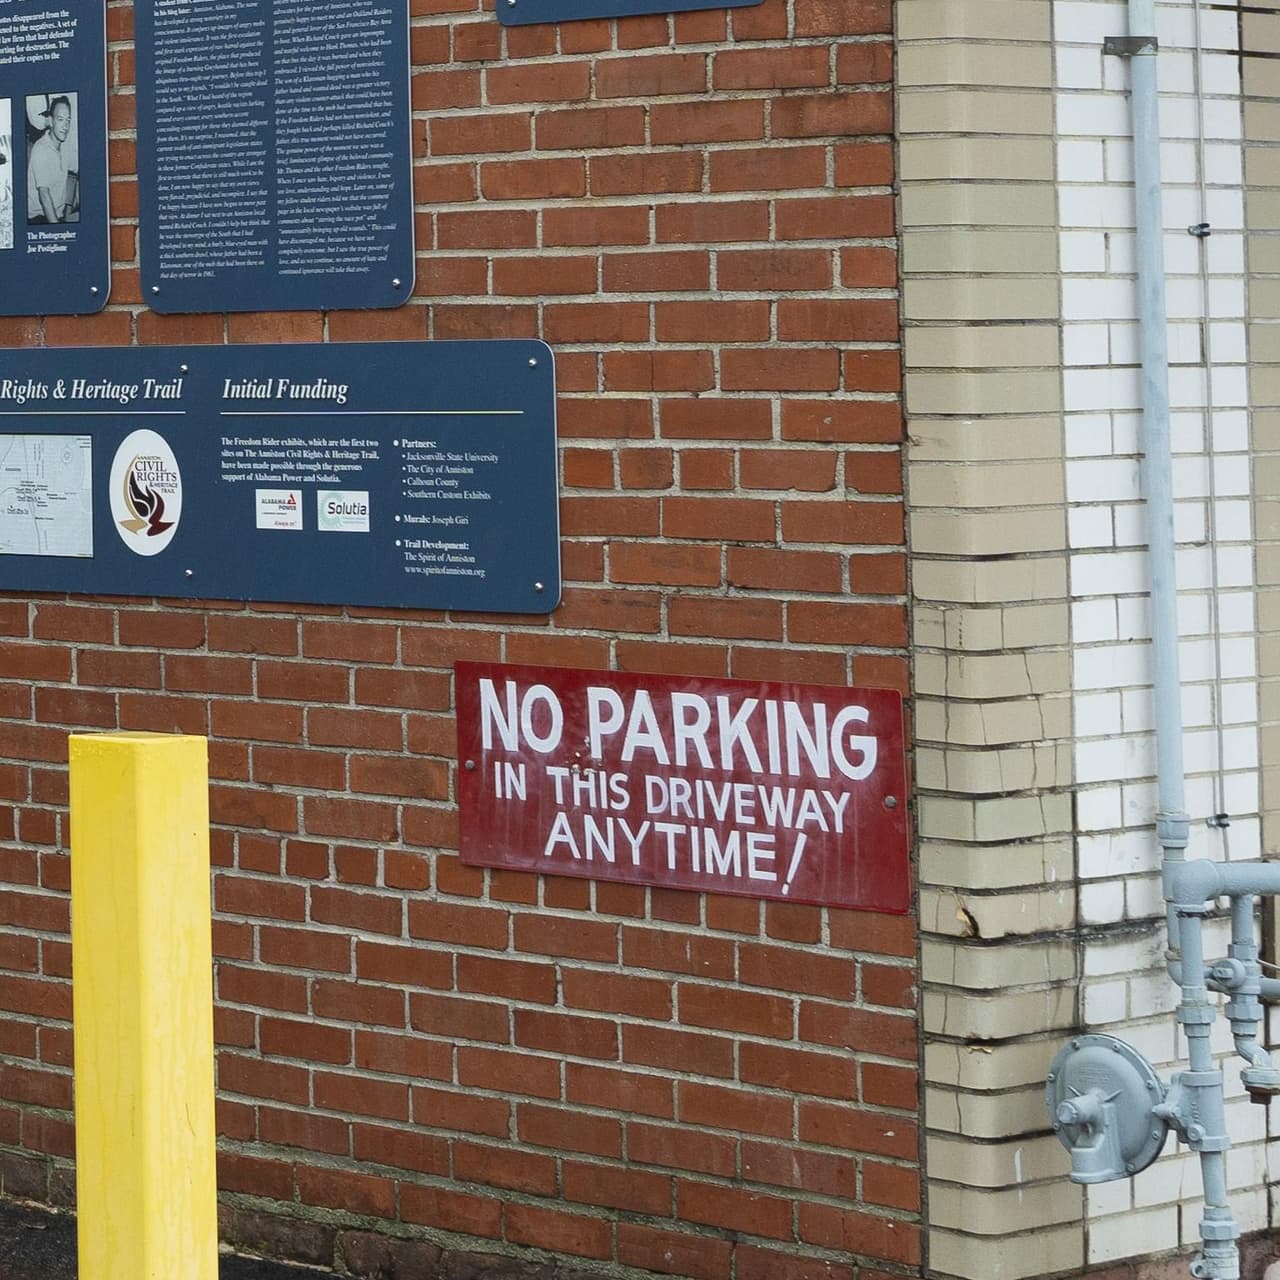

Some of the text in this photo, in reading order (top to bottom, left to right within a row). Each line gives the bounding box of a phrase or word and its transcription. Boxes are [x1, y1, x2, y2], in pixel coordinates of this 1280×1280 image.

[1, 379, 48, 403] Rights
[53, 379, 65, 398] &
[71, 379, 138, 403] Heritage
[144, 379, 182, 398] Trail
[223, 378, 347, 403] Initial Funding
[402, 438, 436, 448] Partners:
[406, 452, 498, 463] Jacksonville State University
[134, 461, 166, 471] CIVIL
[406, 464, 473, 475] The City of Anniston
[136, 472, 176, 482] RIGHTS
[407, 477, 458, 488] Calhoun County
[407, 490, 491, 499] Southern Custom Exhibits
[328, 502, 366, 515] Solutia
[404, 539, 469, 551] Trail Development:
[404, 552, 475, 563] The Spirit of Anniston
[479, 678, 878, 781] NO PARKING
[495, 761, 851, 834] IN THIS DRIVEWAY
[544, 811, 807, 896] ANYTIME!
